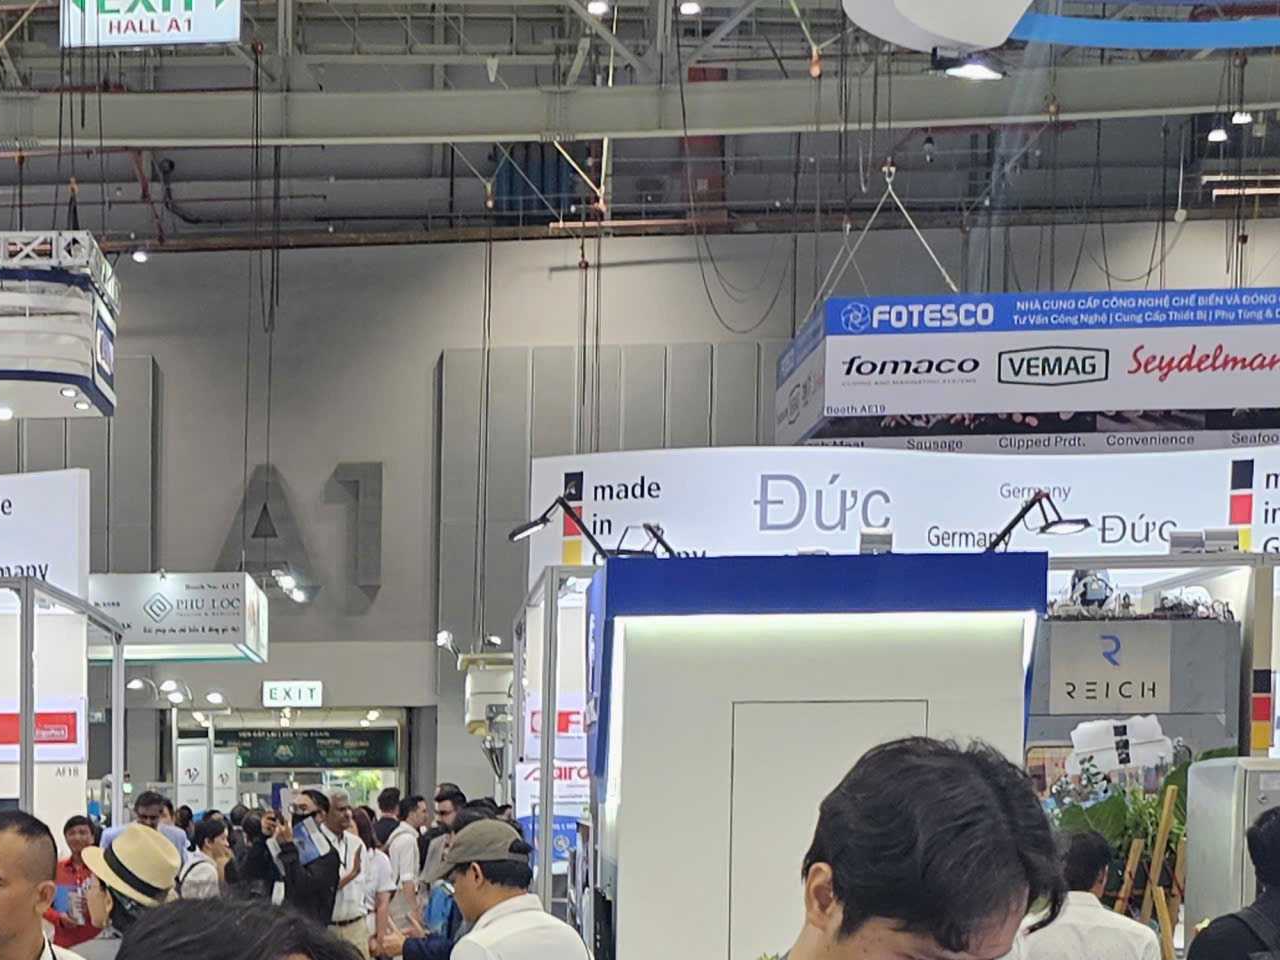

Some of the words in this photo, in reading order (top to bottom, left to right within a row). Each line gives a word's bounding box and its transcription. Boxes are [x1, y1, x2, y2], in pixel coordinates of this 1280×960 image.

[109, 18, 160, 35] HALL
[167, 17, 192, 33] A1
[1016, 297, 1042, 311] NHÀ
[1043, 299, 1077, 311] CUNG
[1078, 297, 1100, 310] CẤP
[1102, 296, 1136, 310] CÔNG
[1138, 295, 1169, 309] NGHỆ
[1225, 293, 1241, 306] VÀ
[872, 303, 995, 329] FOTESCO
[1013, 314, 1028, 325] Tư
[1028, 313, 1049, 325] Vấn
[1050, 313, 1079, 326] Công
[1115, 311, 1143, 324] Cung
[1145, 310, 1167, 324] Cấp
[843, 355, 980, 376] fomaco
[1008, 355, 1097, 377] VEMAG
[826, 404, 858, 415] Booth
[906, 439, 964, 451] Sausage
[998, 436, 1051, 450] Clipped
[1054, 435, 1086, 448] Prdt.
[1106, 434, 1195, 446] Convenience
[593, 476, 662, 501] made
[753, 474, 892, 532] Đức
[592, 513, 612, 536] in
[1098, 513, 1178, 544] Đức
[927, 525, 1005, 548] German
[269, 687, 317, 701] EXIT
[1065, 681, 1157, 699] REICH
